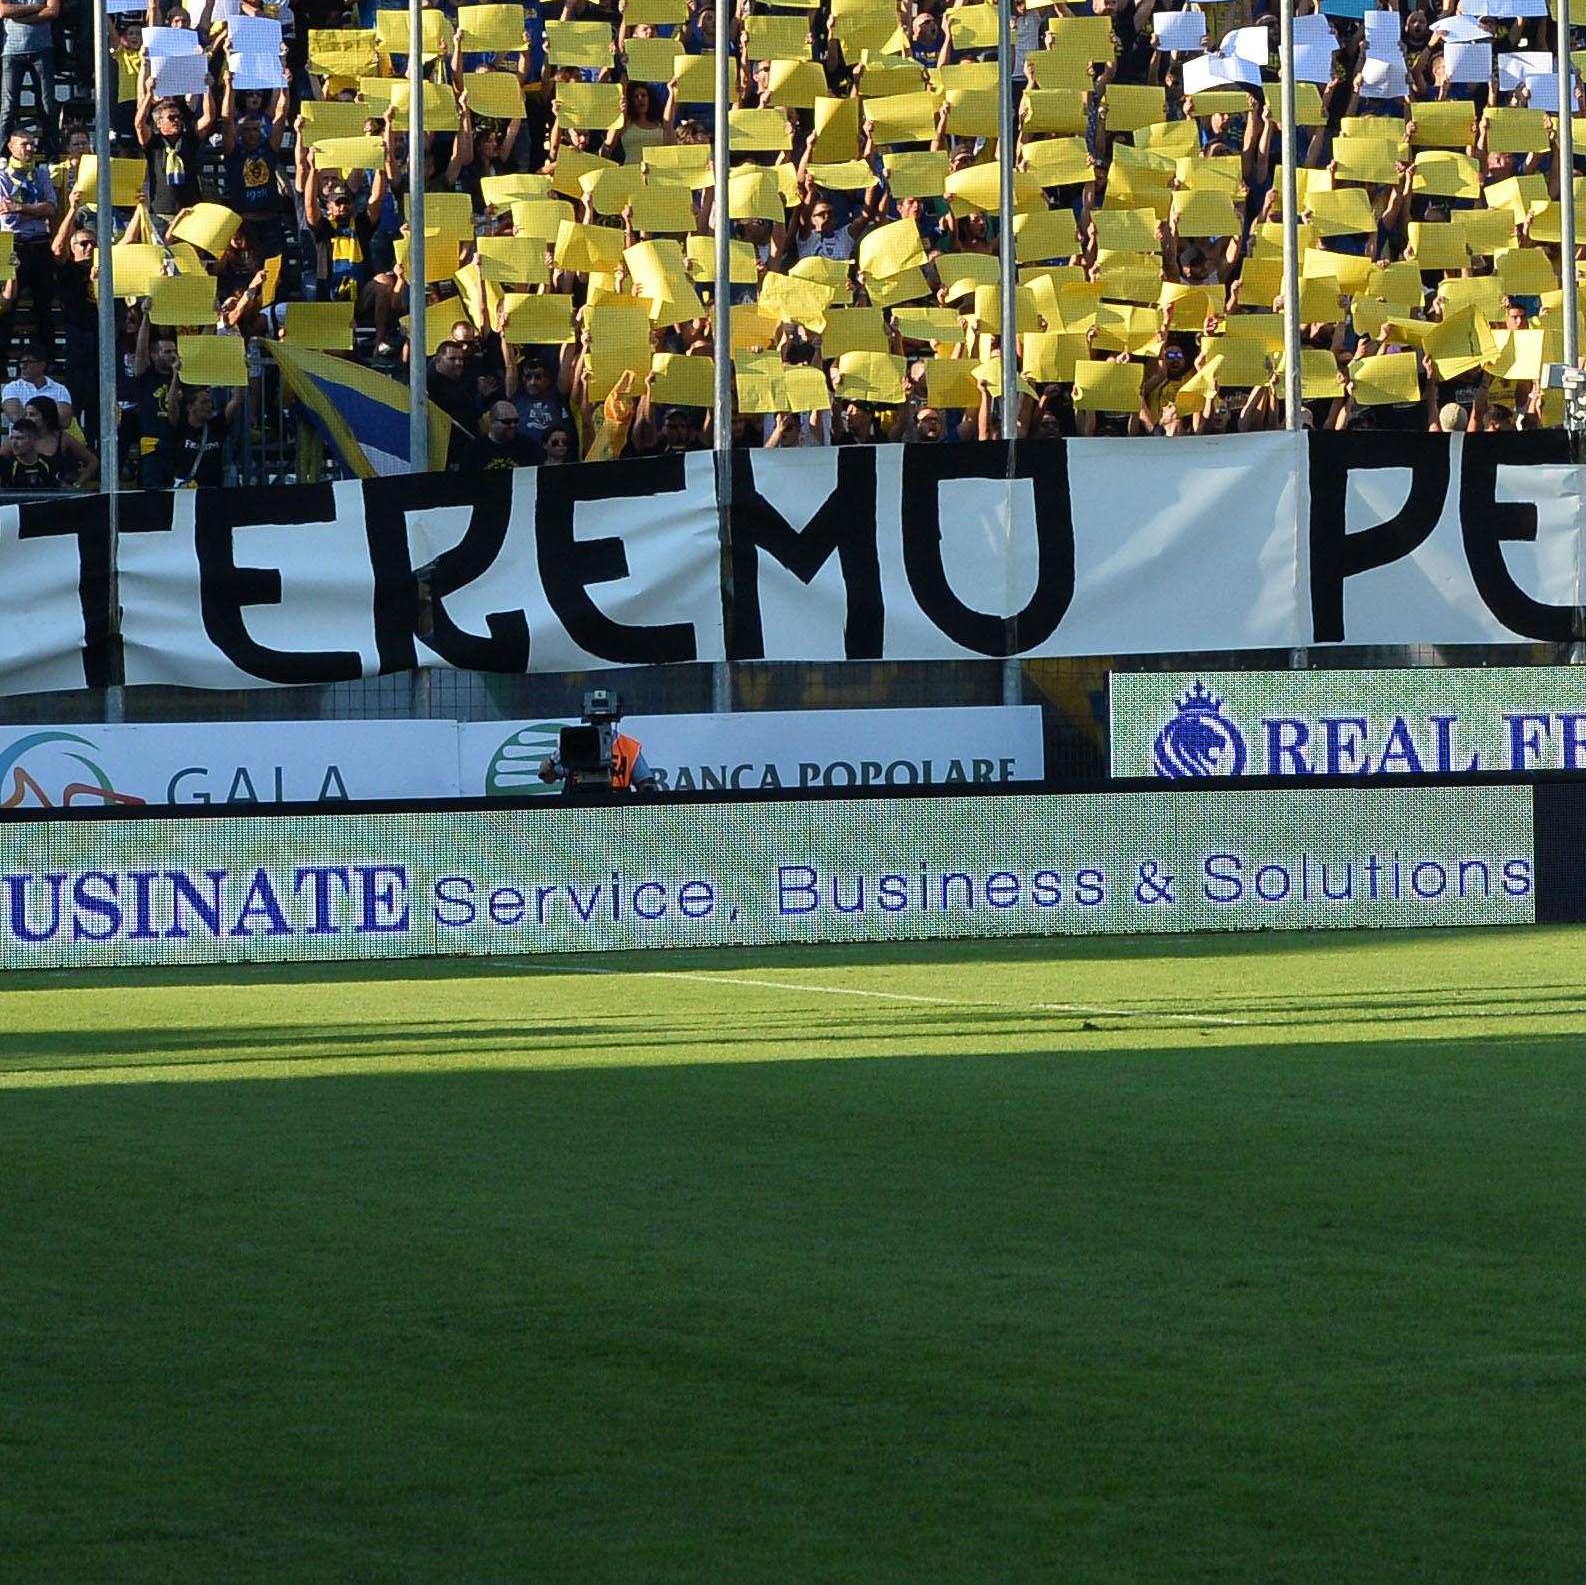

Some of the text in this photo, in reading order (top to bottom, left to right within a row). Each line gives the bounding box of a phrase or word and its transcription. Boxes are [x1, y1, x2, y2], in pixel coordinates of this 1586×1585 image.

[18, 438, 1076, 688] TEREMO
[1262, 715, 1478, 775] REAL
[1, 865, 410, 942] USINATE
[778, 862, 1106, 915] Business
[1136, 860, 1175, 905] &
[1203, 853, 1532, 903] Solutions
